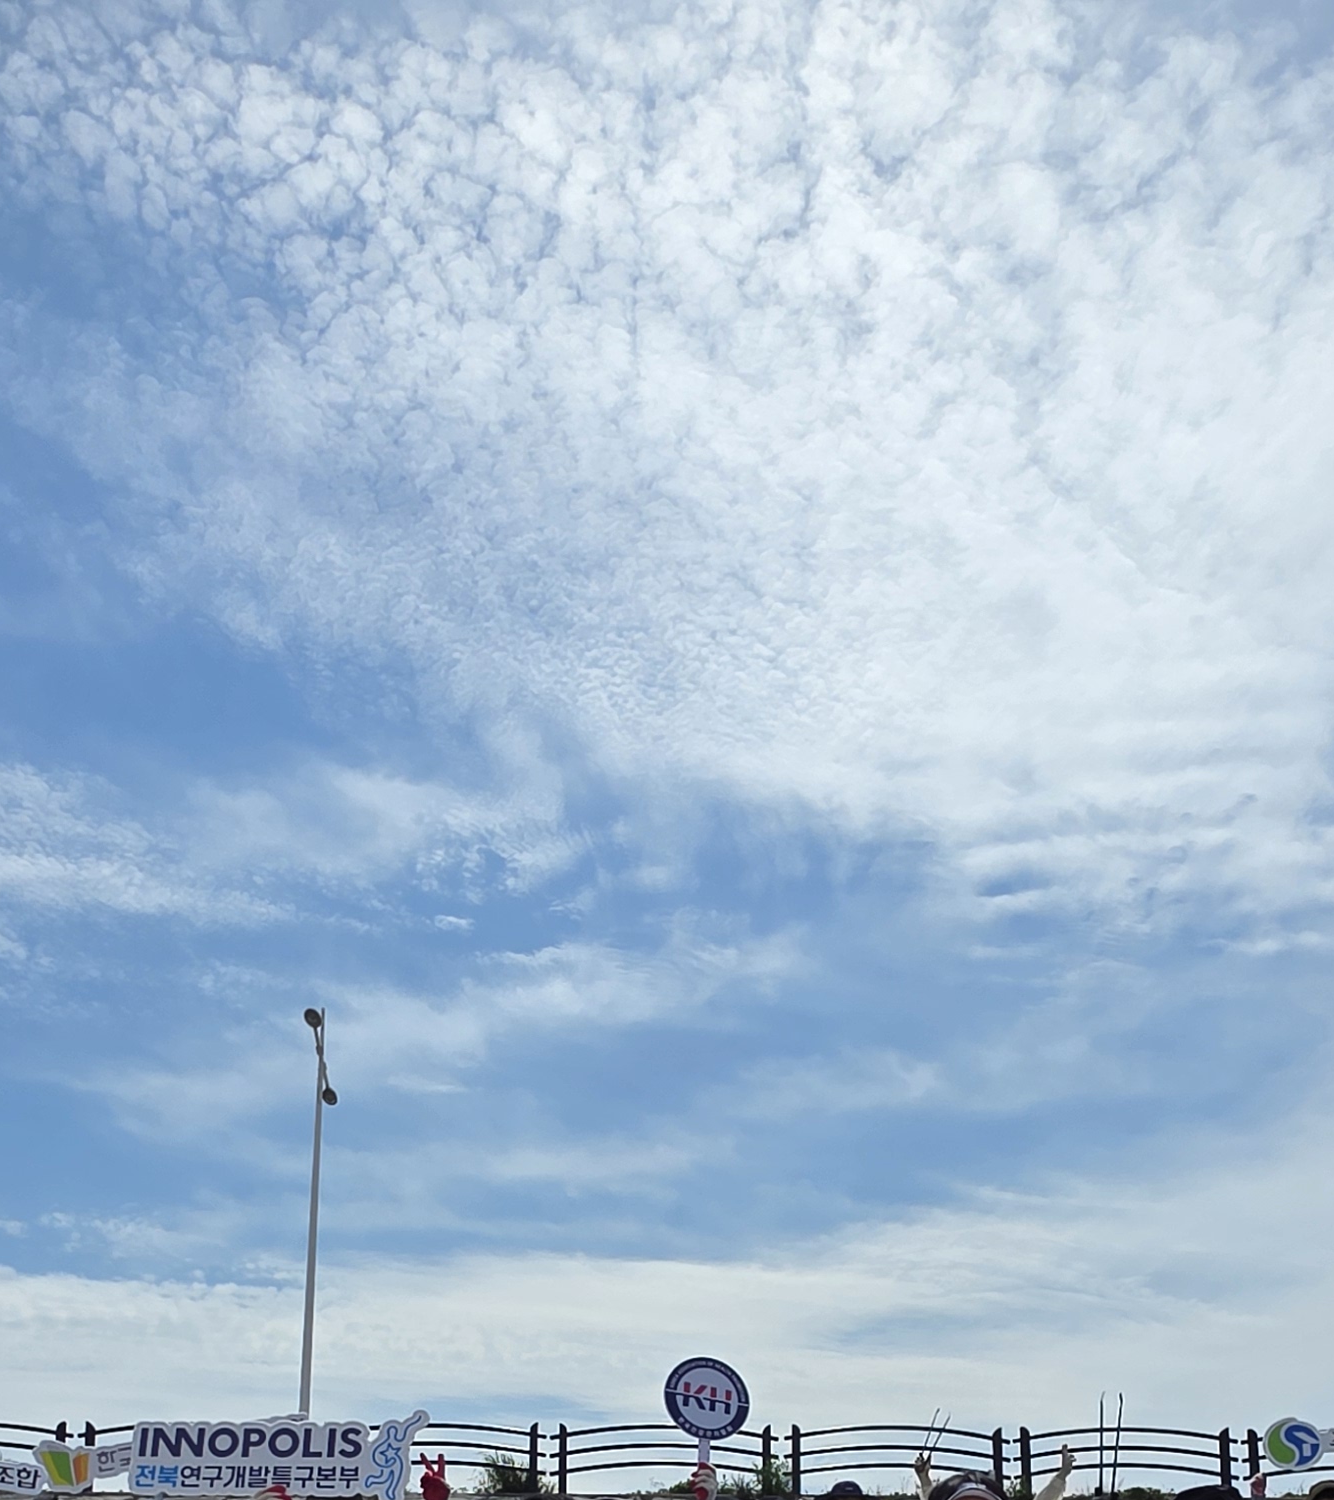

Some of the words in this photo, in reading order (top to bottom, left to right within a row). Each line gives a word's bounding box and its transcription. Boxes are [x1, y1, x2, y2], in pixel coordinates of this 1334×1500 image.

[681, 1381, 732, 1416] KH
[138, 1427, 364, 1459] INNOPOLIS
[135, 1464, 360, 1490] 전북연구개발특구본부
